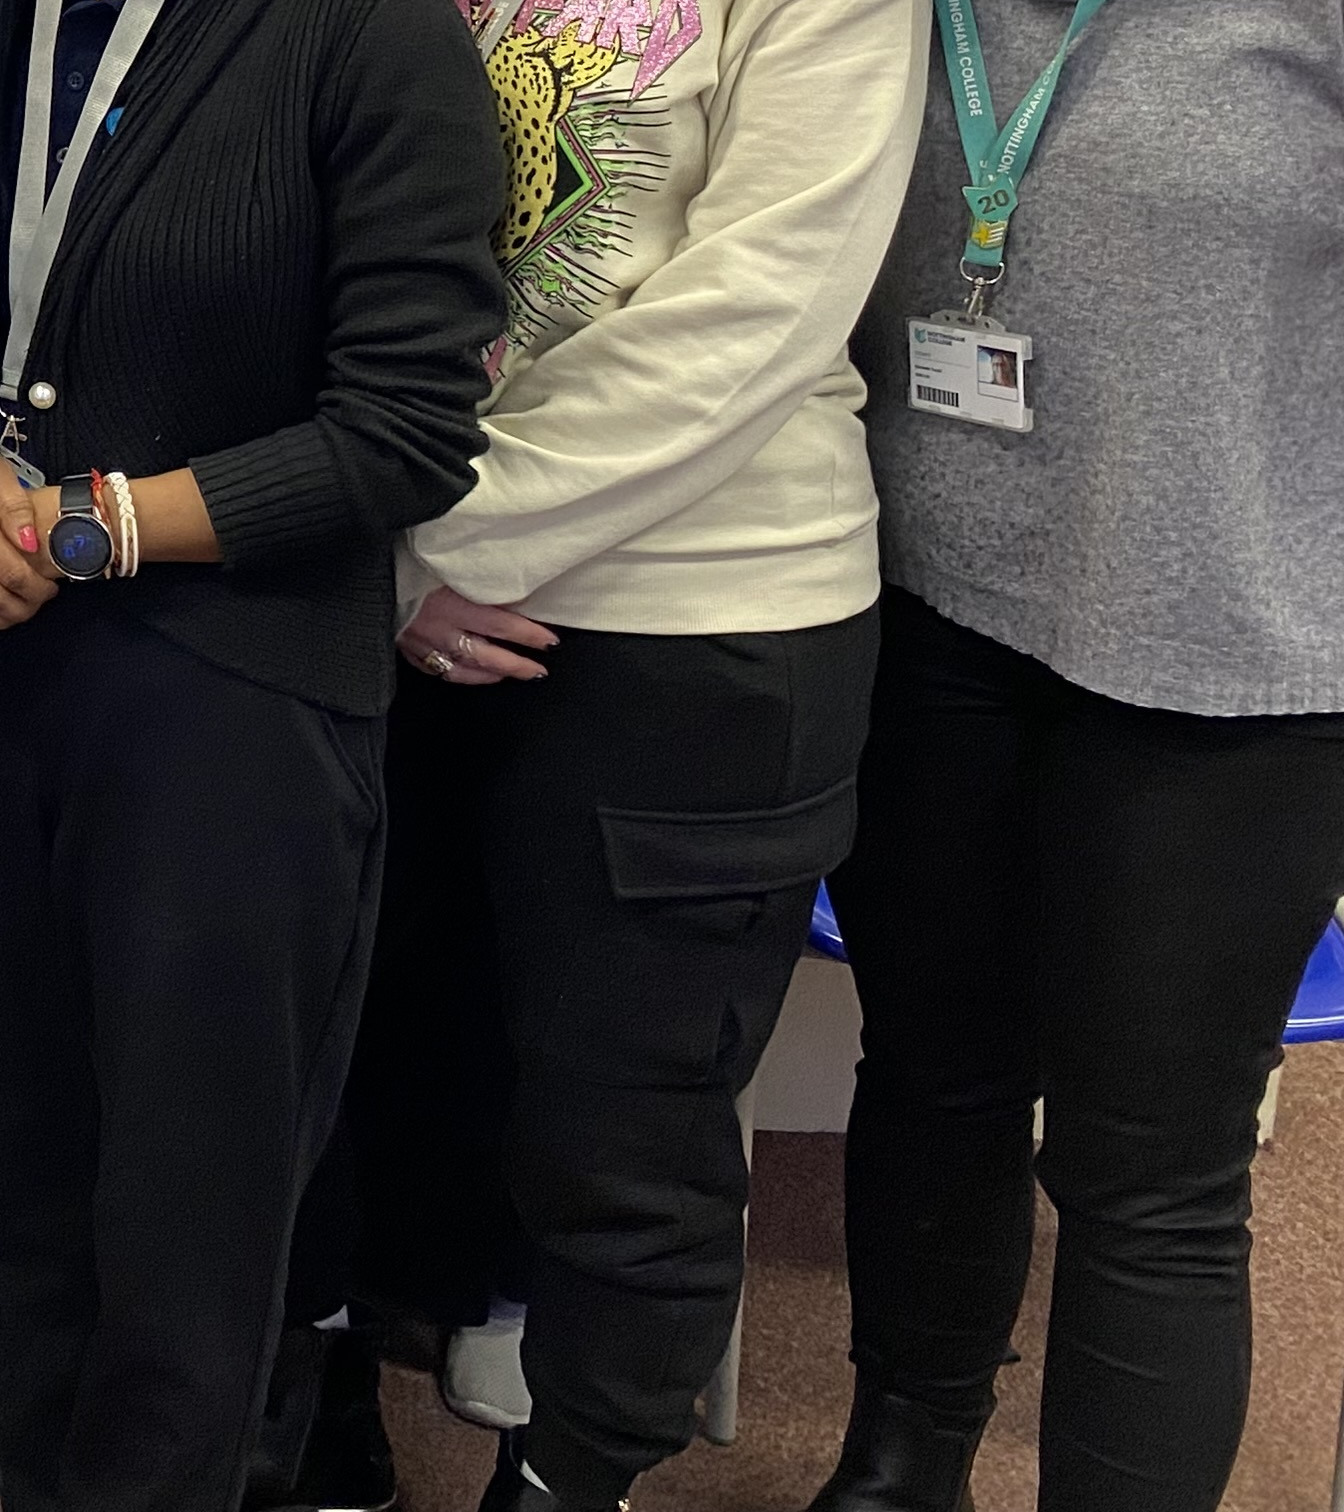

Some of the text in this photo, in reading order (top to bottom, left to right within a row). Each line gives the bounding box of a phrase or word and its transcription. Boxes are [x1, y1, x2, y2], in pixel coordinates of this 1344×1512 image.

[960, 56, 983, 117] COLLEGE
[997, 85, 1047, 175] NOTTINGHAM
[977, 189, 1010, 214] 20
